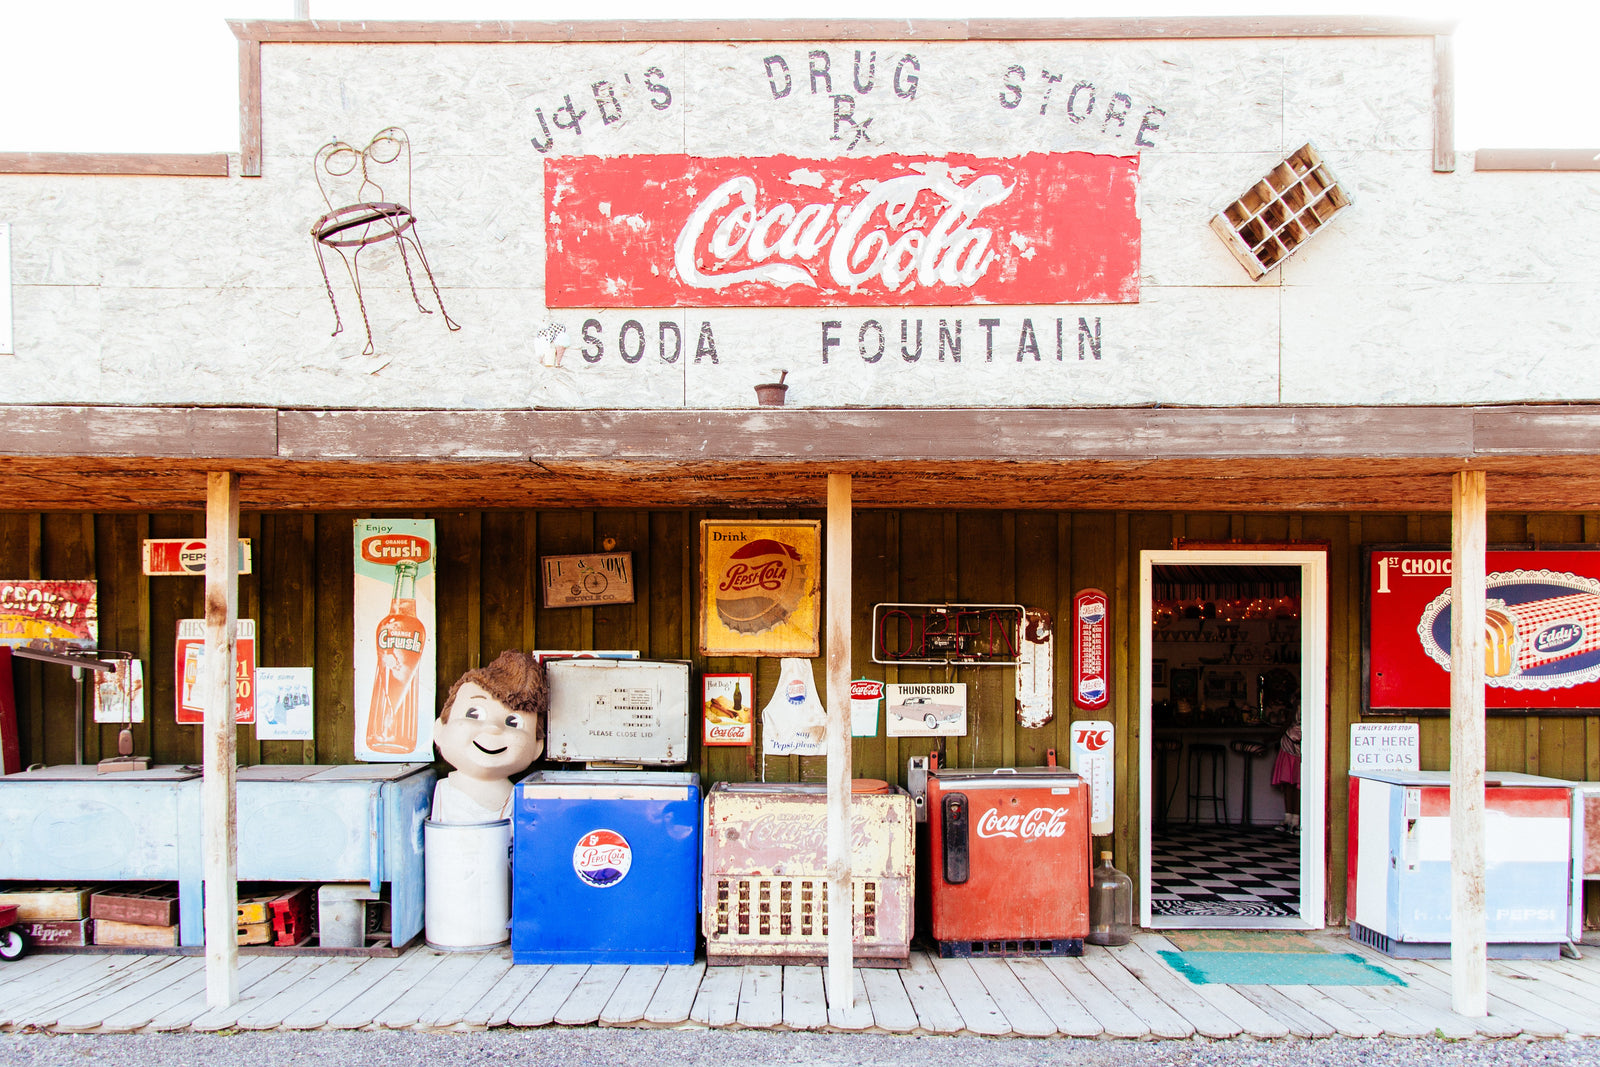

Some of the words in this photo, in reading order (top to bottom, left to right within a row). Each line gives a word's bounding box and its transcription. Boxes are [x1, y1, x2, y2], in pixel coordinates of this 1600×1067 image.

[763, 50, 920, 100] DRUG
[1000, 64, 1166, 148] STORE
[581, 319, 719, 365] SODA
[821, 317, 1102, 364] FOUNTAIN
[366, 524, 393, 533] Enjoy
[713, 531, 747, 541] Drink
[368, 539, 422, 558] Crush
[1401, 559, 1452, 574] CHOIC
[1, 585, 78, 624] CROWN
[378, 629, 421, 652] Crush
[880, 610, 1020, 658] OPEN
[1539, 625, 1580, 644] Eddy's
[899, 686, 955, 694] THUNDERBIRD
[796, 731, 810, 739] say
[1074, 730, 1111, 751] RC
[1354, 736, 1376, 746] EAT
[1381, 736, 1415, 746] HERE
[1357, 753, 1380, 763] GET
[1385, 753, 1412, 763] GAS
[1496, 909, 1555, 921] PEPSI
[31, 924, 72, 941] Pepper
